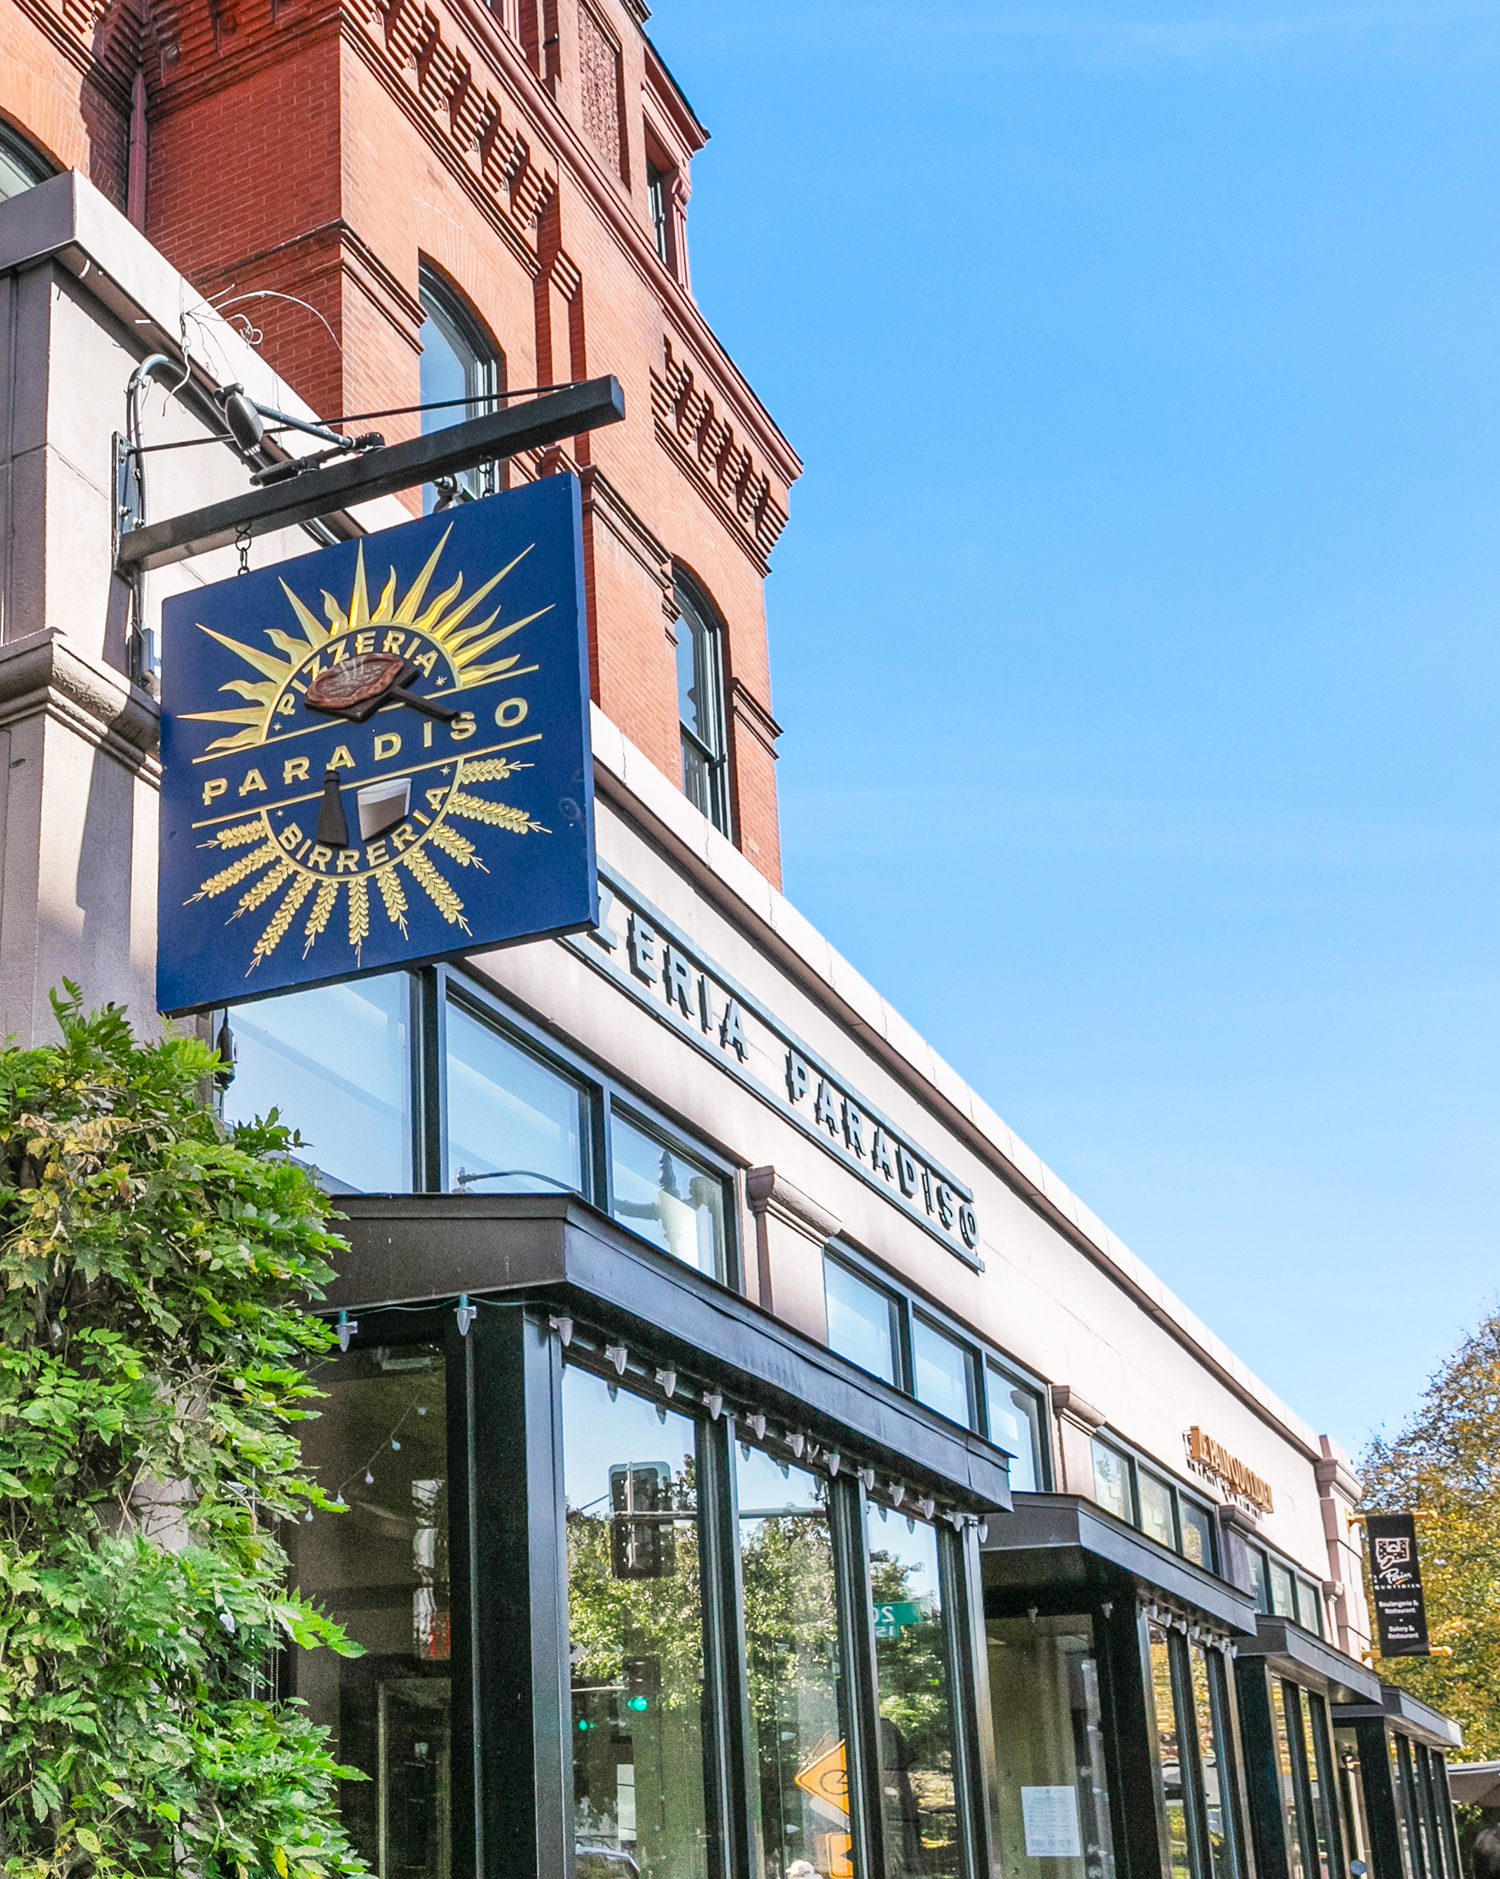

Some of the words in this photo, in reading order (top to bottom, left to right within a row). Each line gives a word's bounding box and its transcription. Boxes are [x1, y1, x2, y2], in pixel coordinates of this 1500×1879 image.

[277, 630, 438, 716] PIZZERIA
[202, 697, 529, 806] PARADISO
[278, 786, 449, 874] BIRRERIA
[787, 1049, 980, 1248] PARADISO
[1378, 1568, 1412, 1585] Pain
